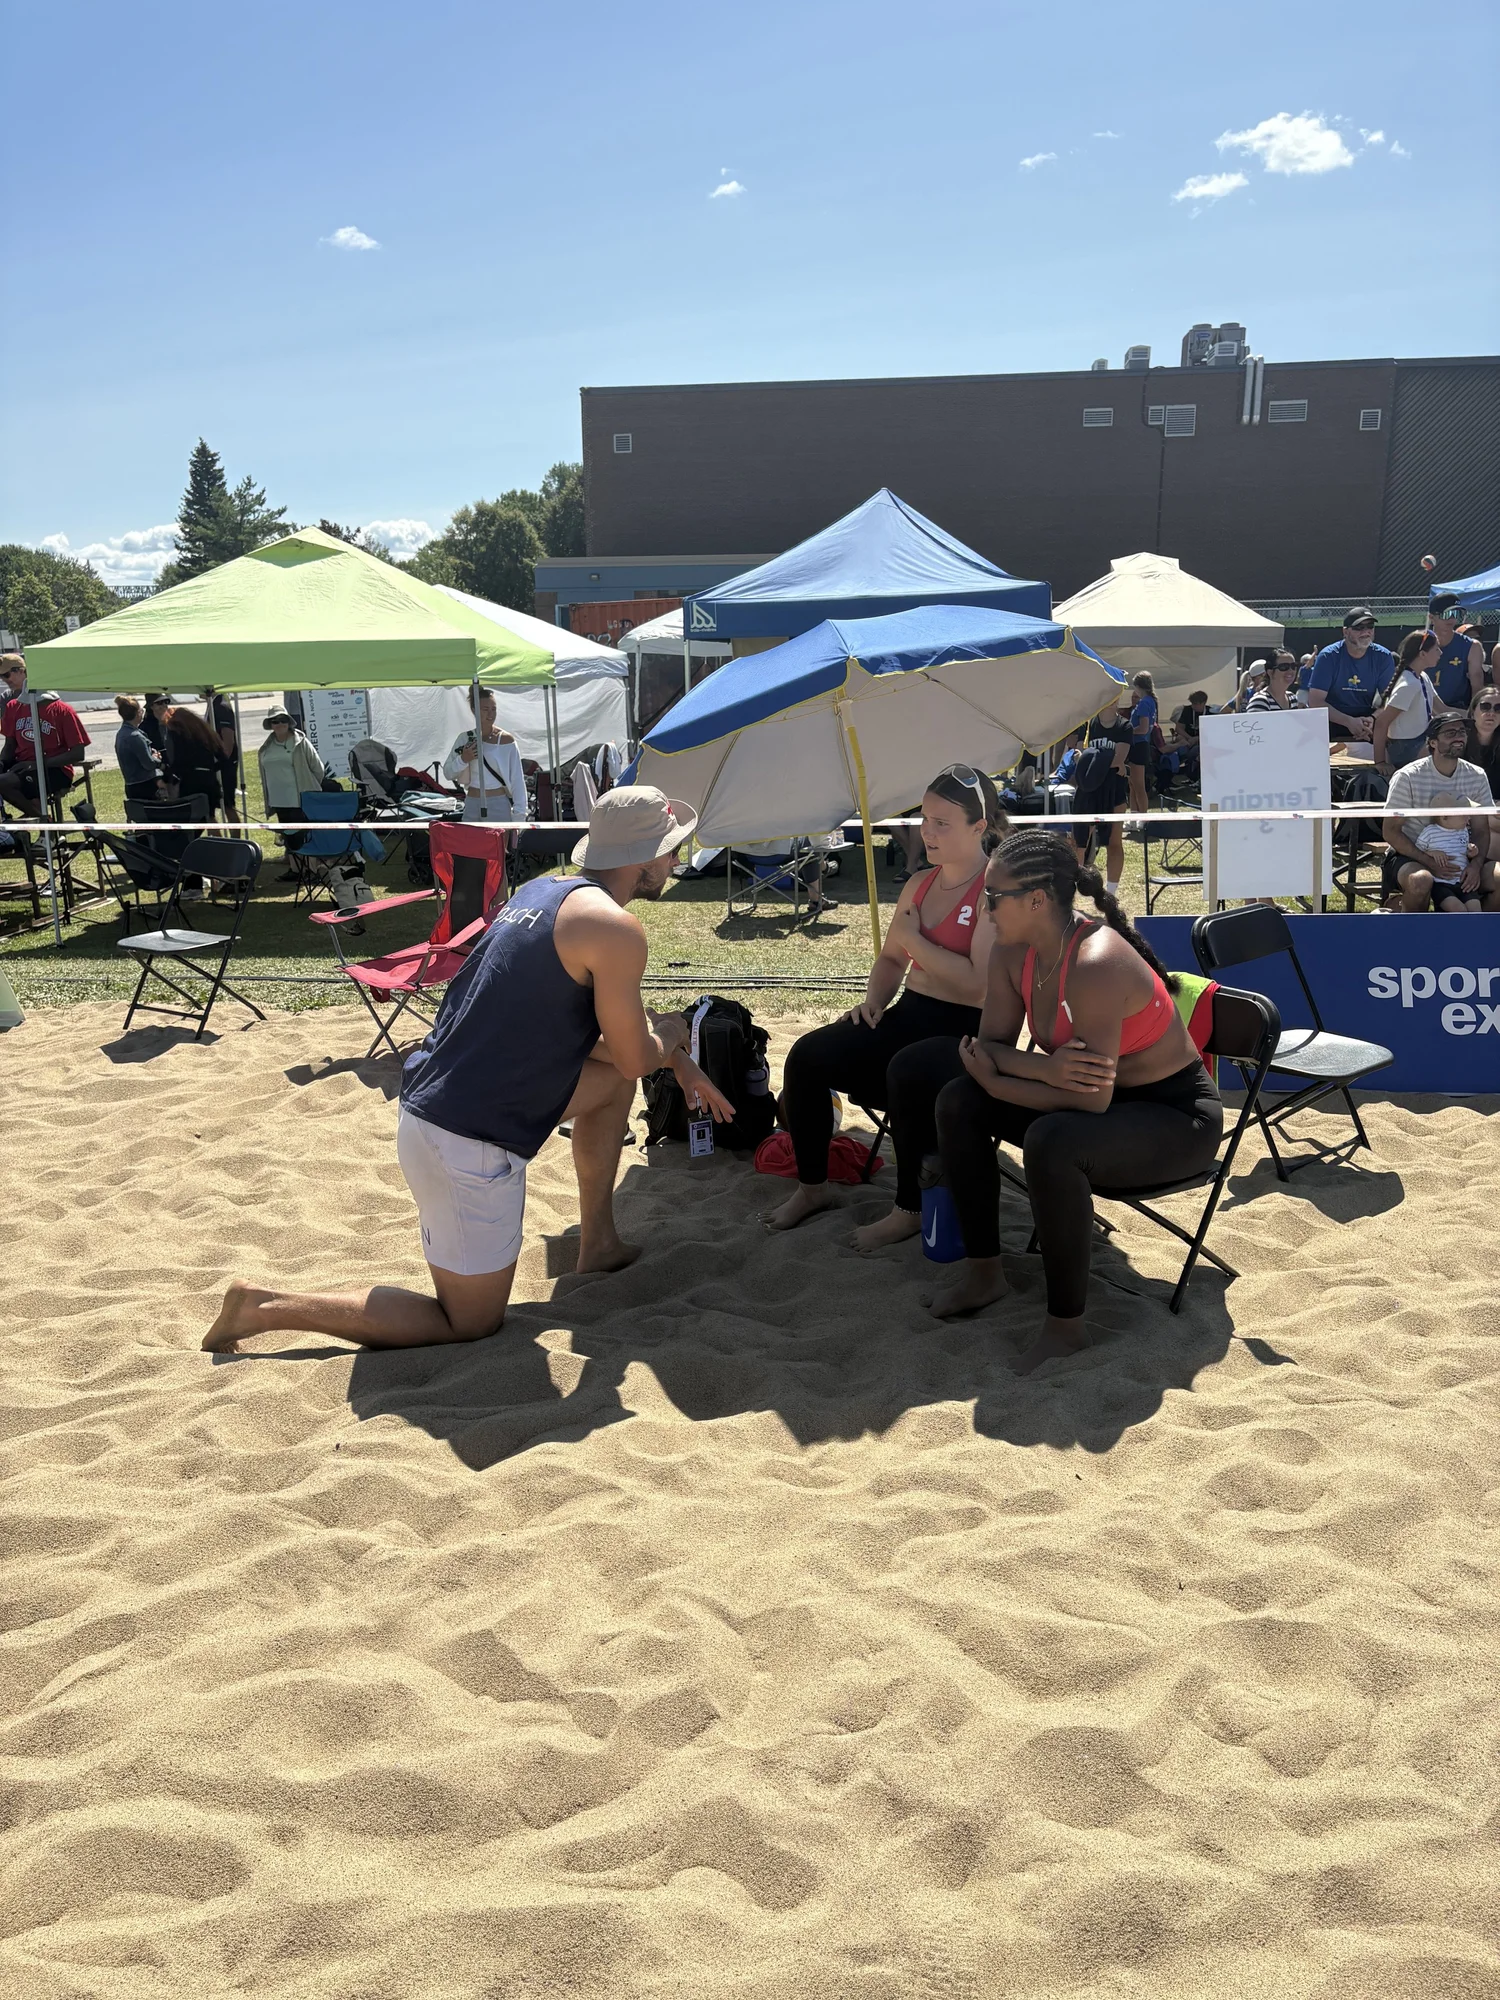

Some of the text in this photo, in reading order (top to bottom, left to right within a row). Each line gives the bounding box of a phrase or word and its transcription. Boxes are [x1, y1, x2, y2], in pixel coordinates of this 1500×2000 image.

[1232, 720, 1264, 733] ESC
[493, 906, 544, 929] OACH
[956, 904, 974, 927] 2
[1367, 966, 1500, 1008] spor
[1441, 1002, 1500, 1036] ex
